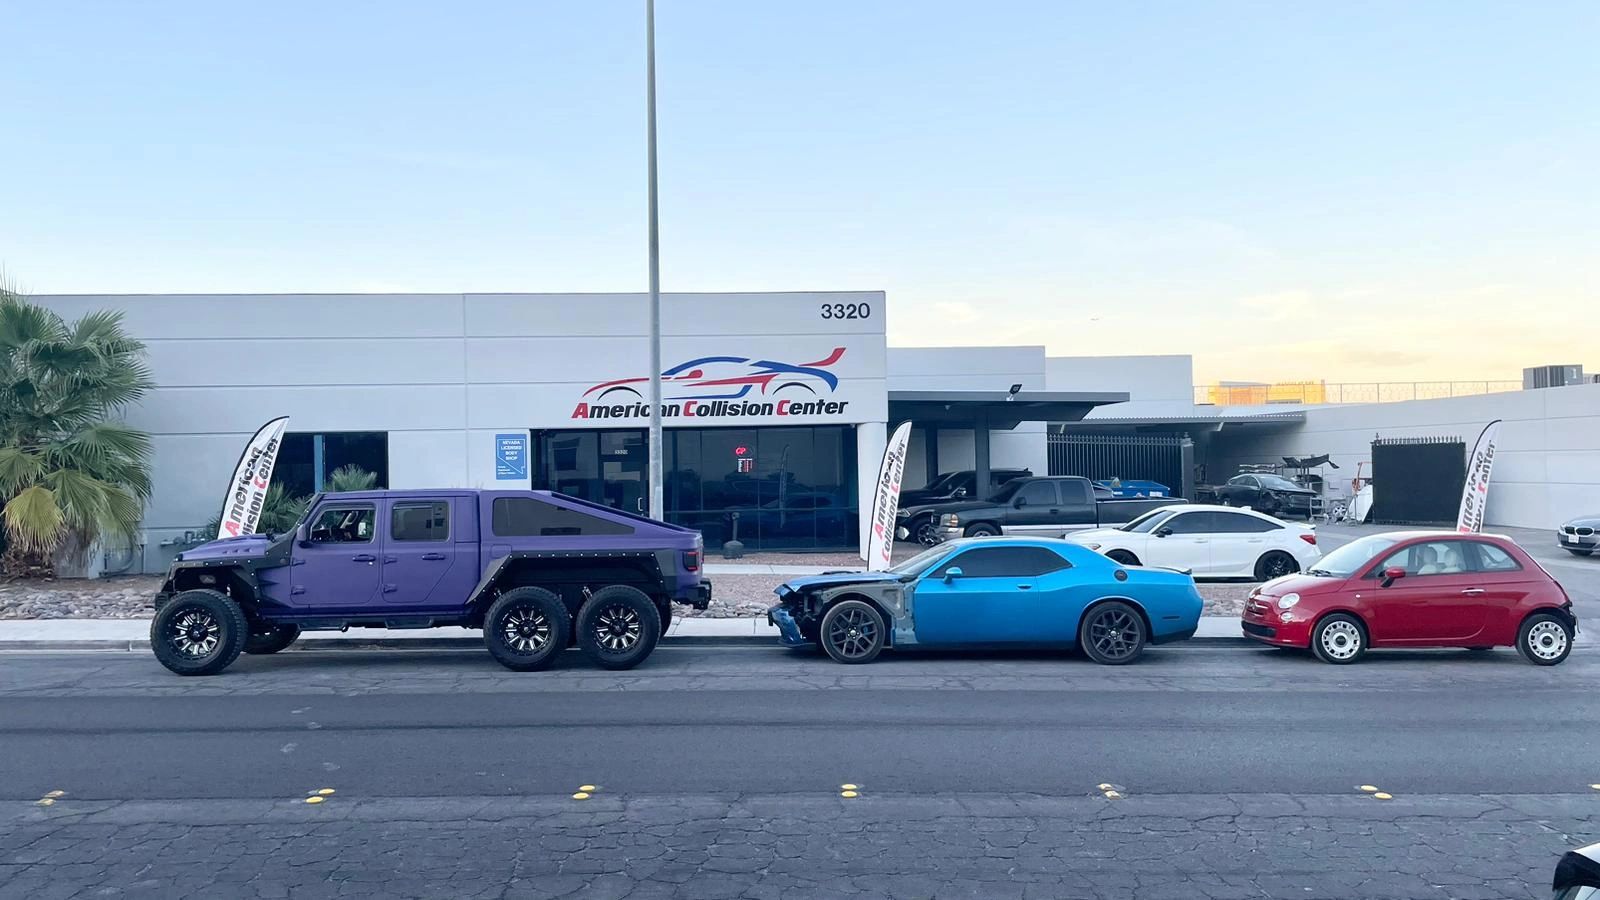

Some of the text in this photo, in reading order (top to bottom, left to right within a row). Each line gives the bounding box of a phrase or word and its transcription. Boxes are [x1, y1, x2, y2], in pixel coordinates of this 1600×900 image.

[820, 302, 871, 319] 3320
[683, 399, 774, 417] Collision
[776, 398, 848, 416] Center
[254, 438, 278, 489] Center
[881, 439, 906, 562] Collision Center
